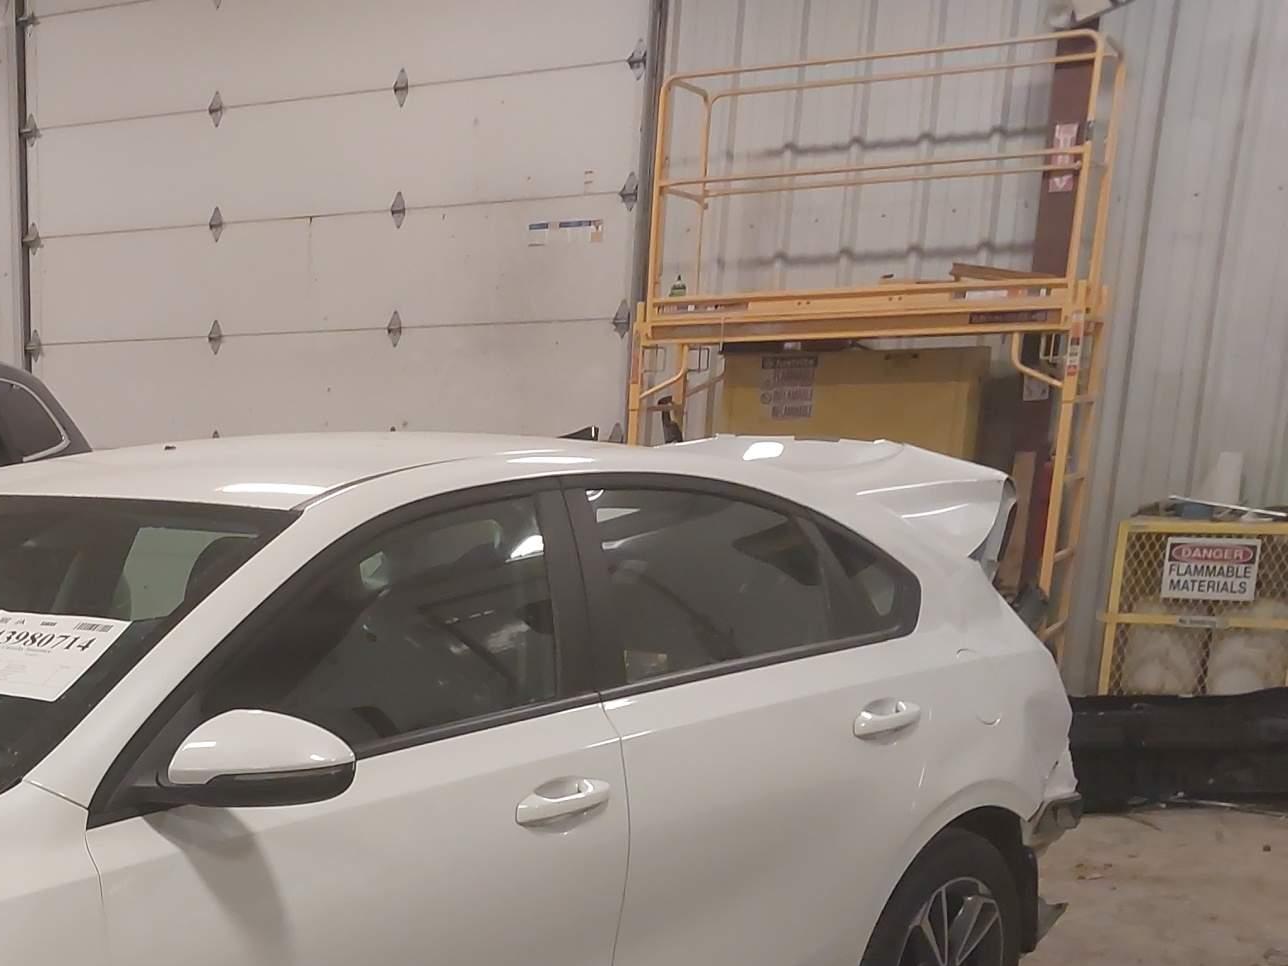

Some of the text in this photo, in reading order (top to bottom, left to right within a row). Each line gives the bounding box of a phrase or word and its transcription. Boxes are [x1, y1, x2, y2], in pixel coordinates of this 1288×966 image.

[1180, 546, 1244, 560] DANGER
[1168, 563, 1252, 578] FLAMMABLE
[1168, 579, 1248, 594] MATERIALS
